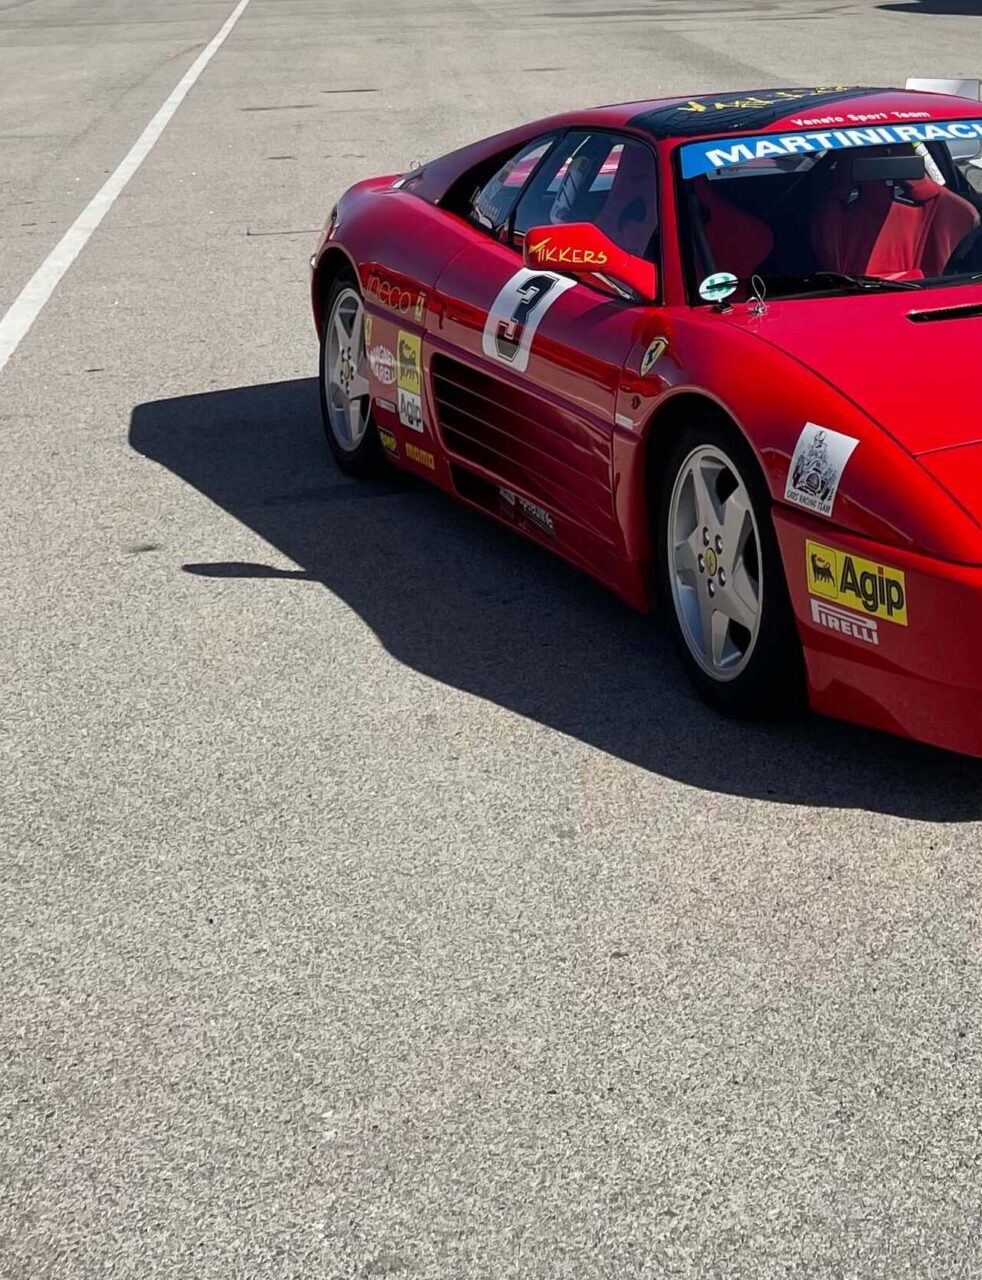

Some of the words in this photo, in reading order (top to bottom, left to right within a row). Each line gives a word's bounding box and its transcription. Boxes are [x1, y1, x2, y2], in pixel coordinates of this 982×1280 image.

[846, 112, 888, 122] Sport
[890, 111, 931, 119] Team
[704, 125, 897, 168] MARTINI
[533, 243, 607, 264] TIKKERS
[494, 273, 561, 363] 3
[840, 556, 905, 617] Agip
[811, 599, 878, 644] PIRELLI
